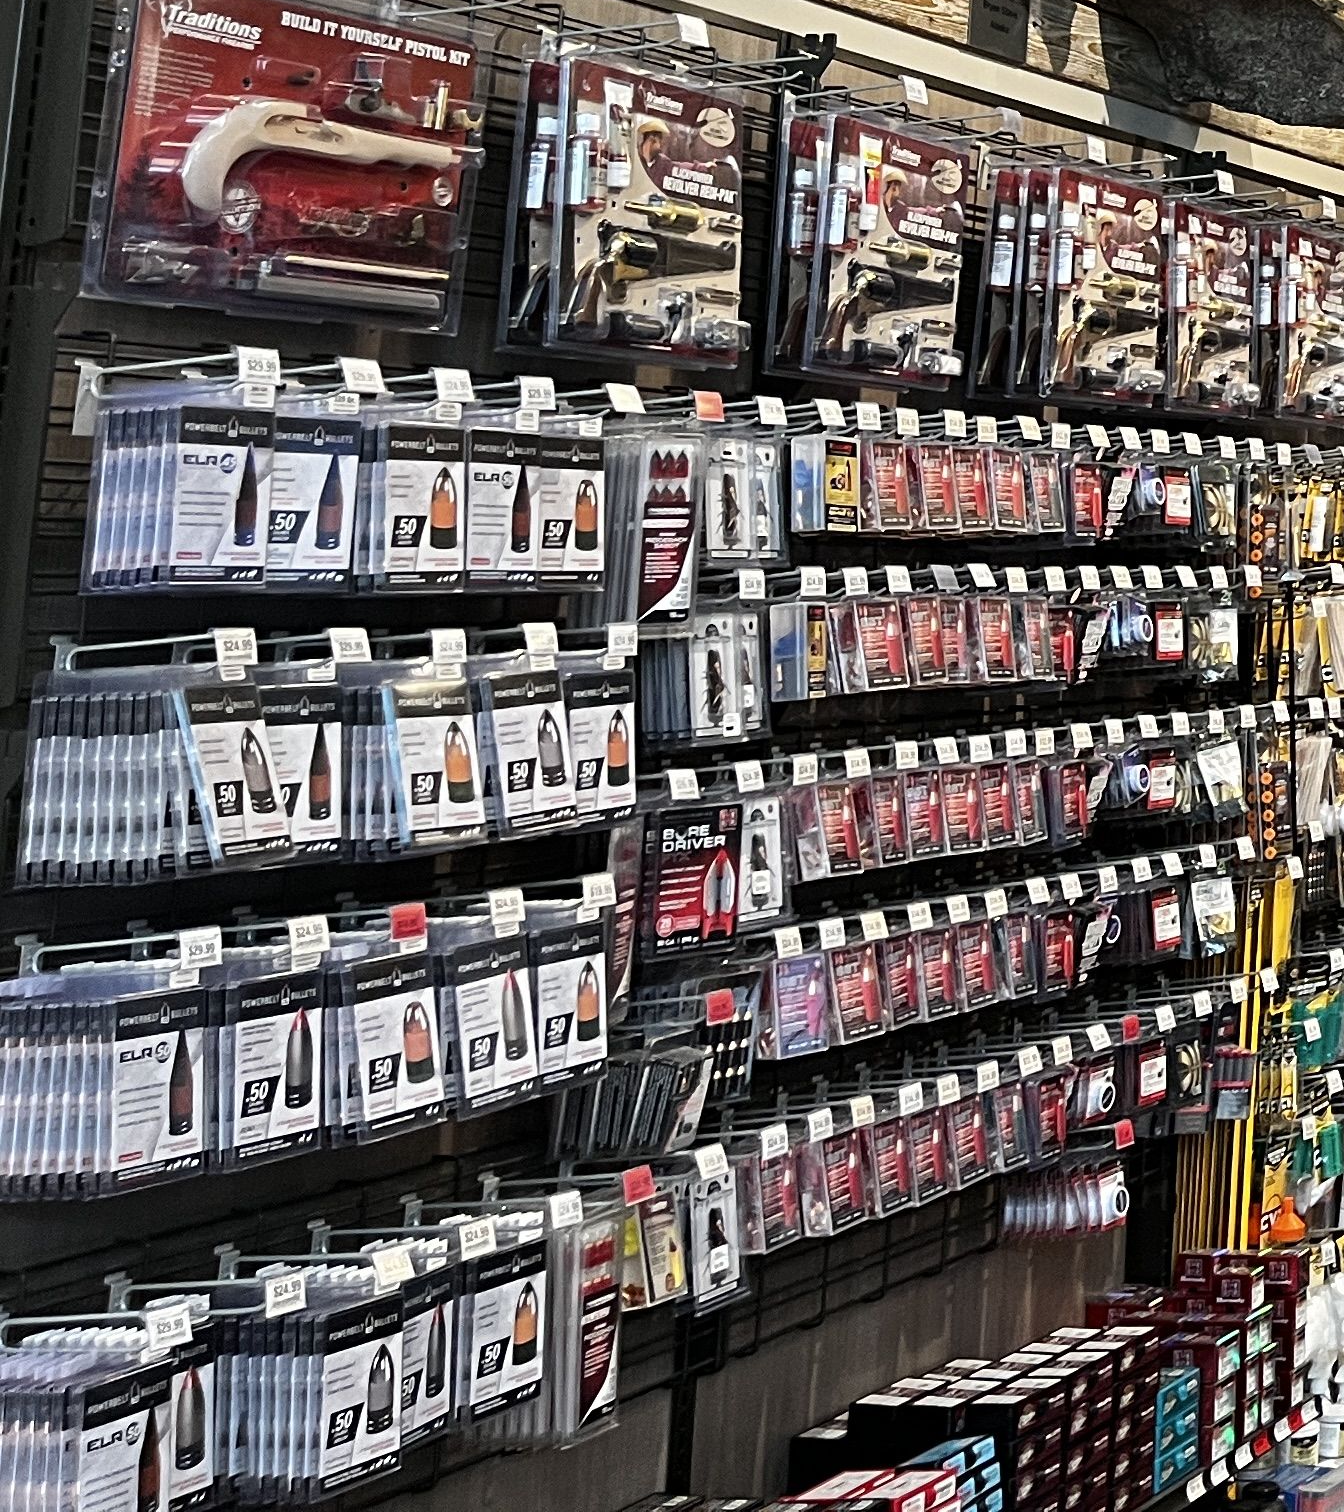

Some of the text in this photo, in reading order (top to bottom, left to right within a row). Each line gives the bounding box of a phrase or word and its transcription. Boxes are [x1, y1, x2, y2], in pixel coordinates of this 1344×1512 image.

[168, 4, 263, 40] Traditions
[281, 10, 471, 67] BUILD IT YOURSELF PISTOL KIT
[247, 359, 277, 373] $29.99
[182, 453, 218, 467] ELR
[473, 472, 500, 483] ELR
[269, 512, 297, 532] .50
[394, 517, 418, 536] .50
[545, 521, 565, 538] .50
[223, 639, 253, 653] $24.99
[510, 761, 530, 781] .50
[577, 760, 598, 779] .50
[413, 774, 435, 794] .50
[217, 784, 238, 805] .50
[662, 824, 711, 842] BORE
[662, 835, 726, 853] DRIVER
[188, 943, 216, 958] $29.99
[547, 1016, 567, 1037] .50
[119, 1047, 154, 1064] ELR
[472, 1037, 491, 1059] .50
[371, 1057, 393, 1080] .50
[245, 1080, 270, 1104] .50
[273, 1280, 302, 1298] $24.99
[481, 1342, 502, 1365] .50
[331, 1409, 355, 1435] .50
[87, 1431, 124, 1453] ELR
